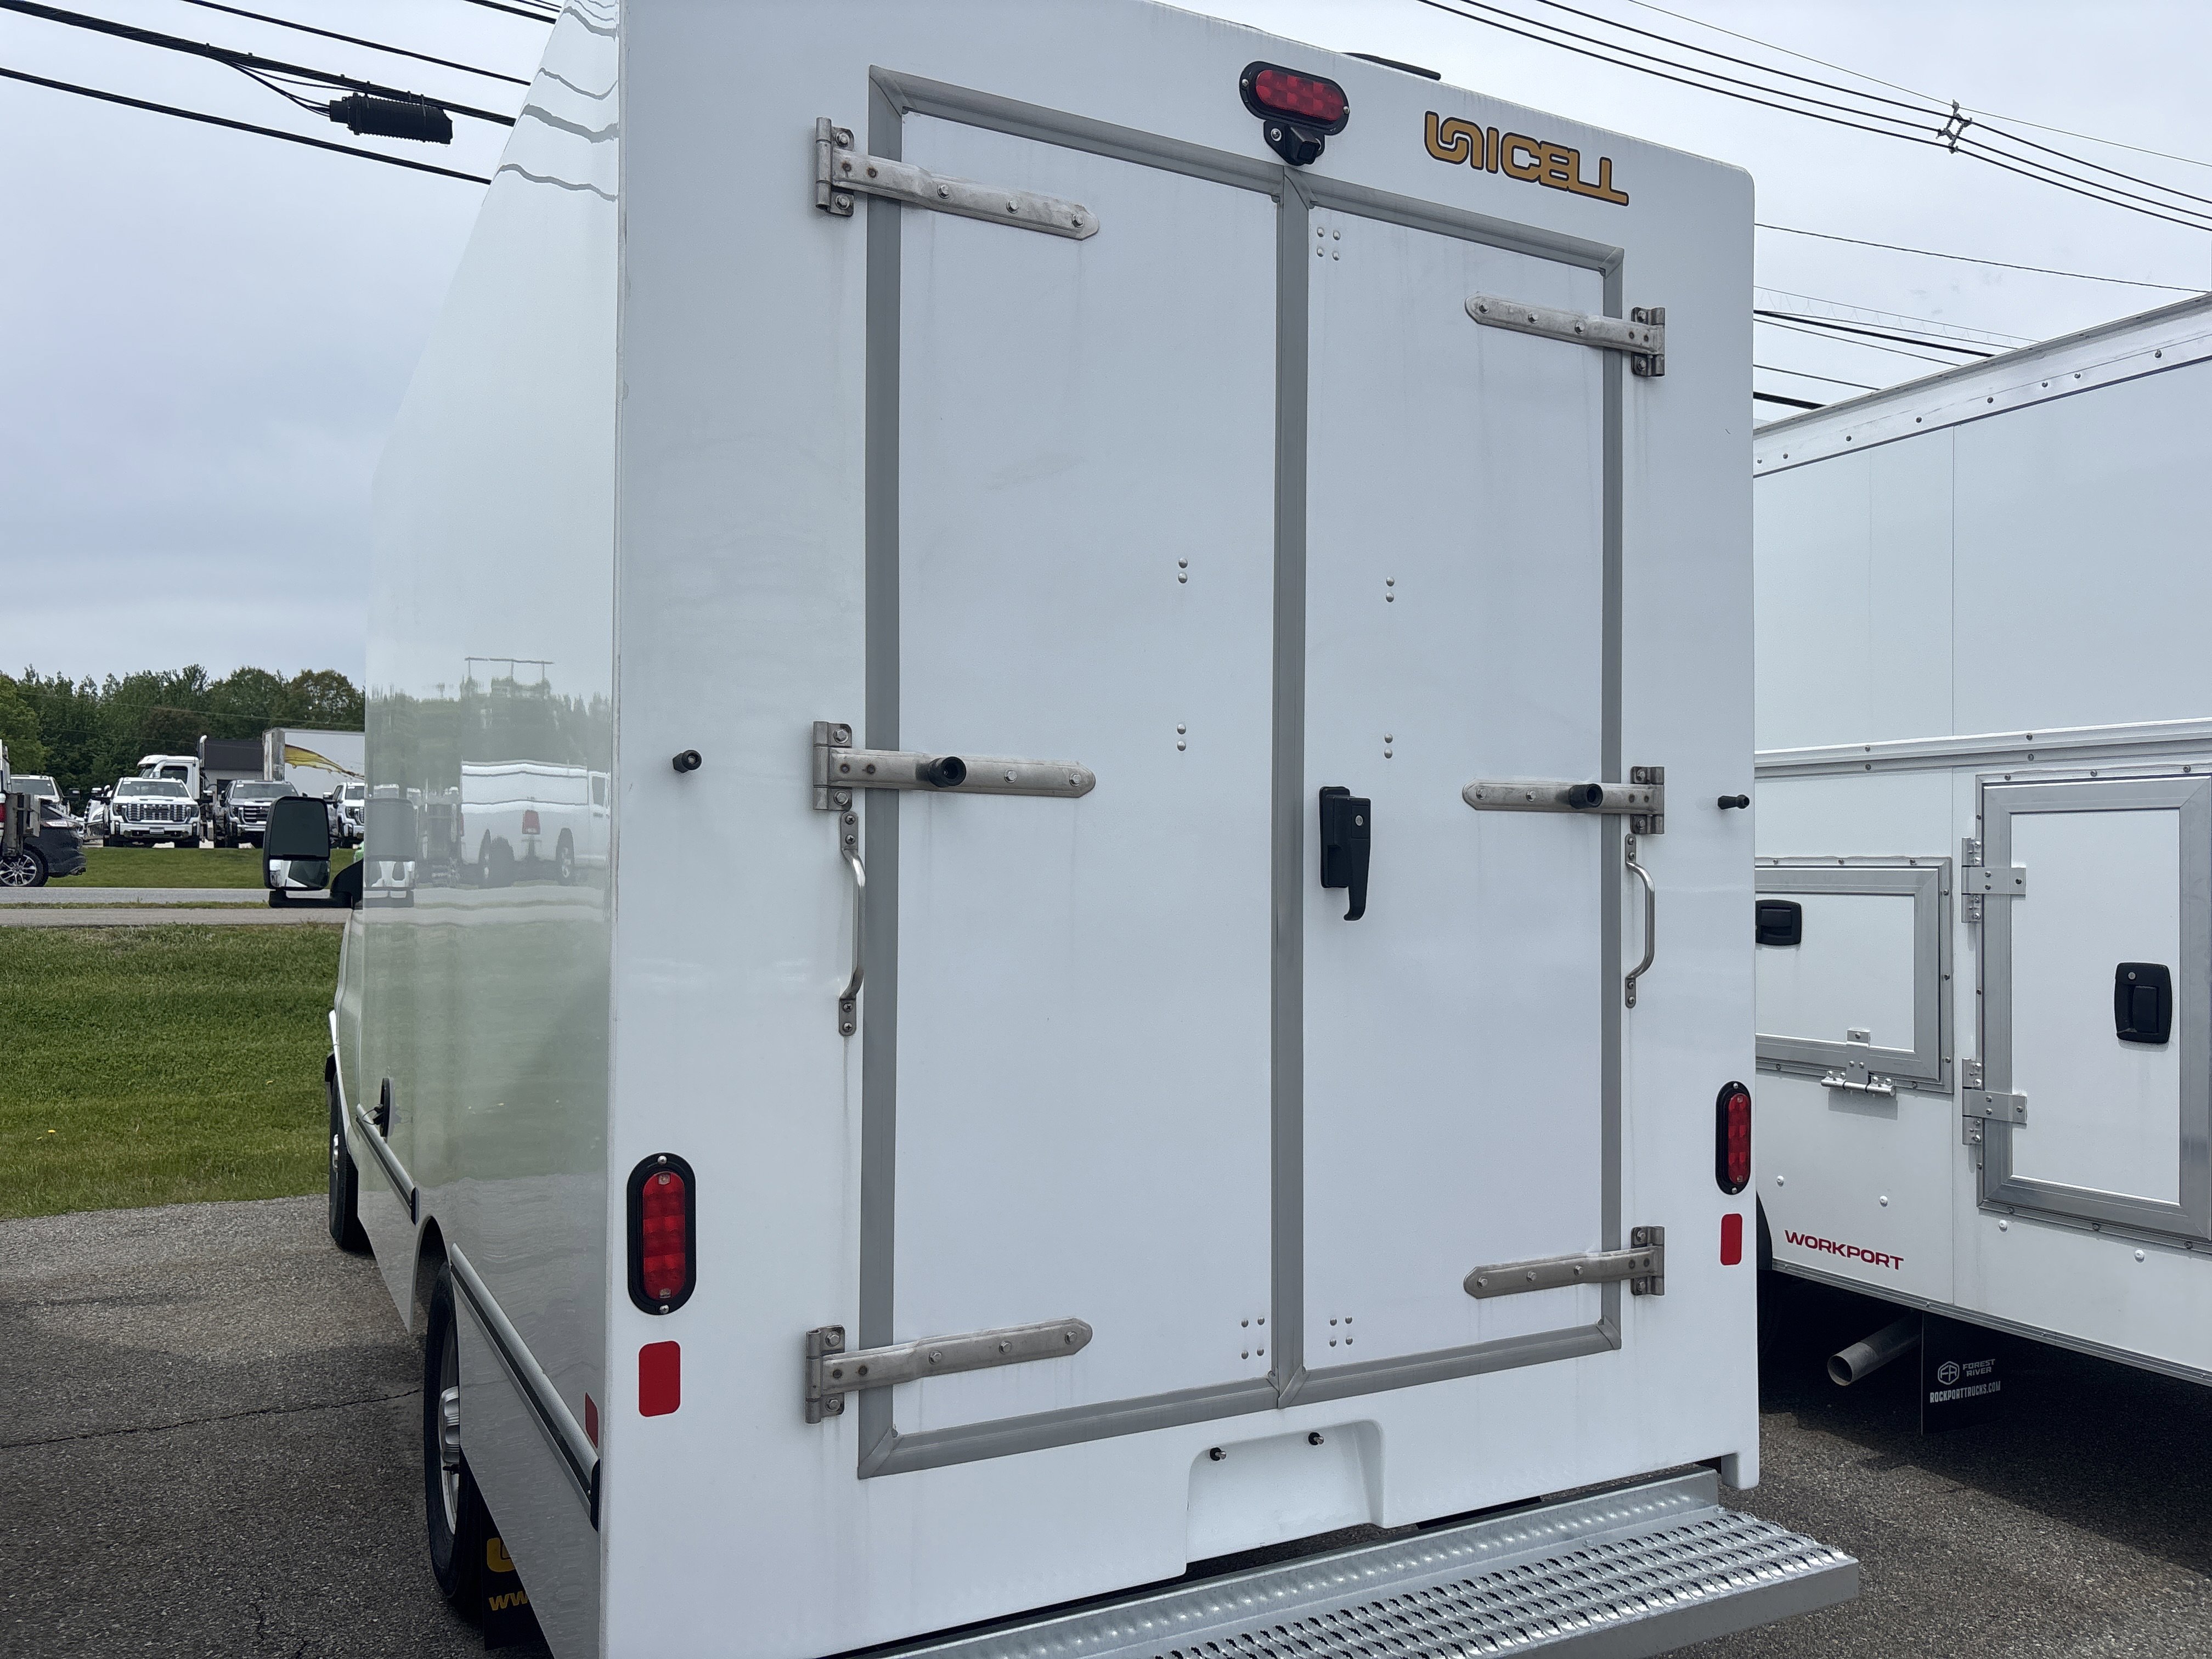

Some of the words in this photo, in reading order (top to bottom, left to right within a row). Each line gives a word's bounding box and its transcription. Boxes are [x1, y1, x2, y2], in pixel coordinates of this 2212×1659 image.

[1425, 111, 1629, 206] UNICELL
[1785, 1229, 1904, 1271] WORKPORT
[1962, 1358, 1996, 1371] FOREST
[1966, 1366, 1992, 1377] RIVER
[1929, 1380, 2001, 1403] ROCKPORTTRUCKS.COM
